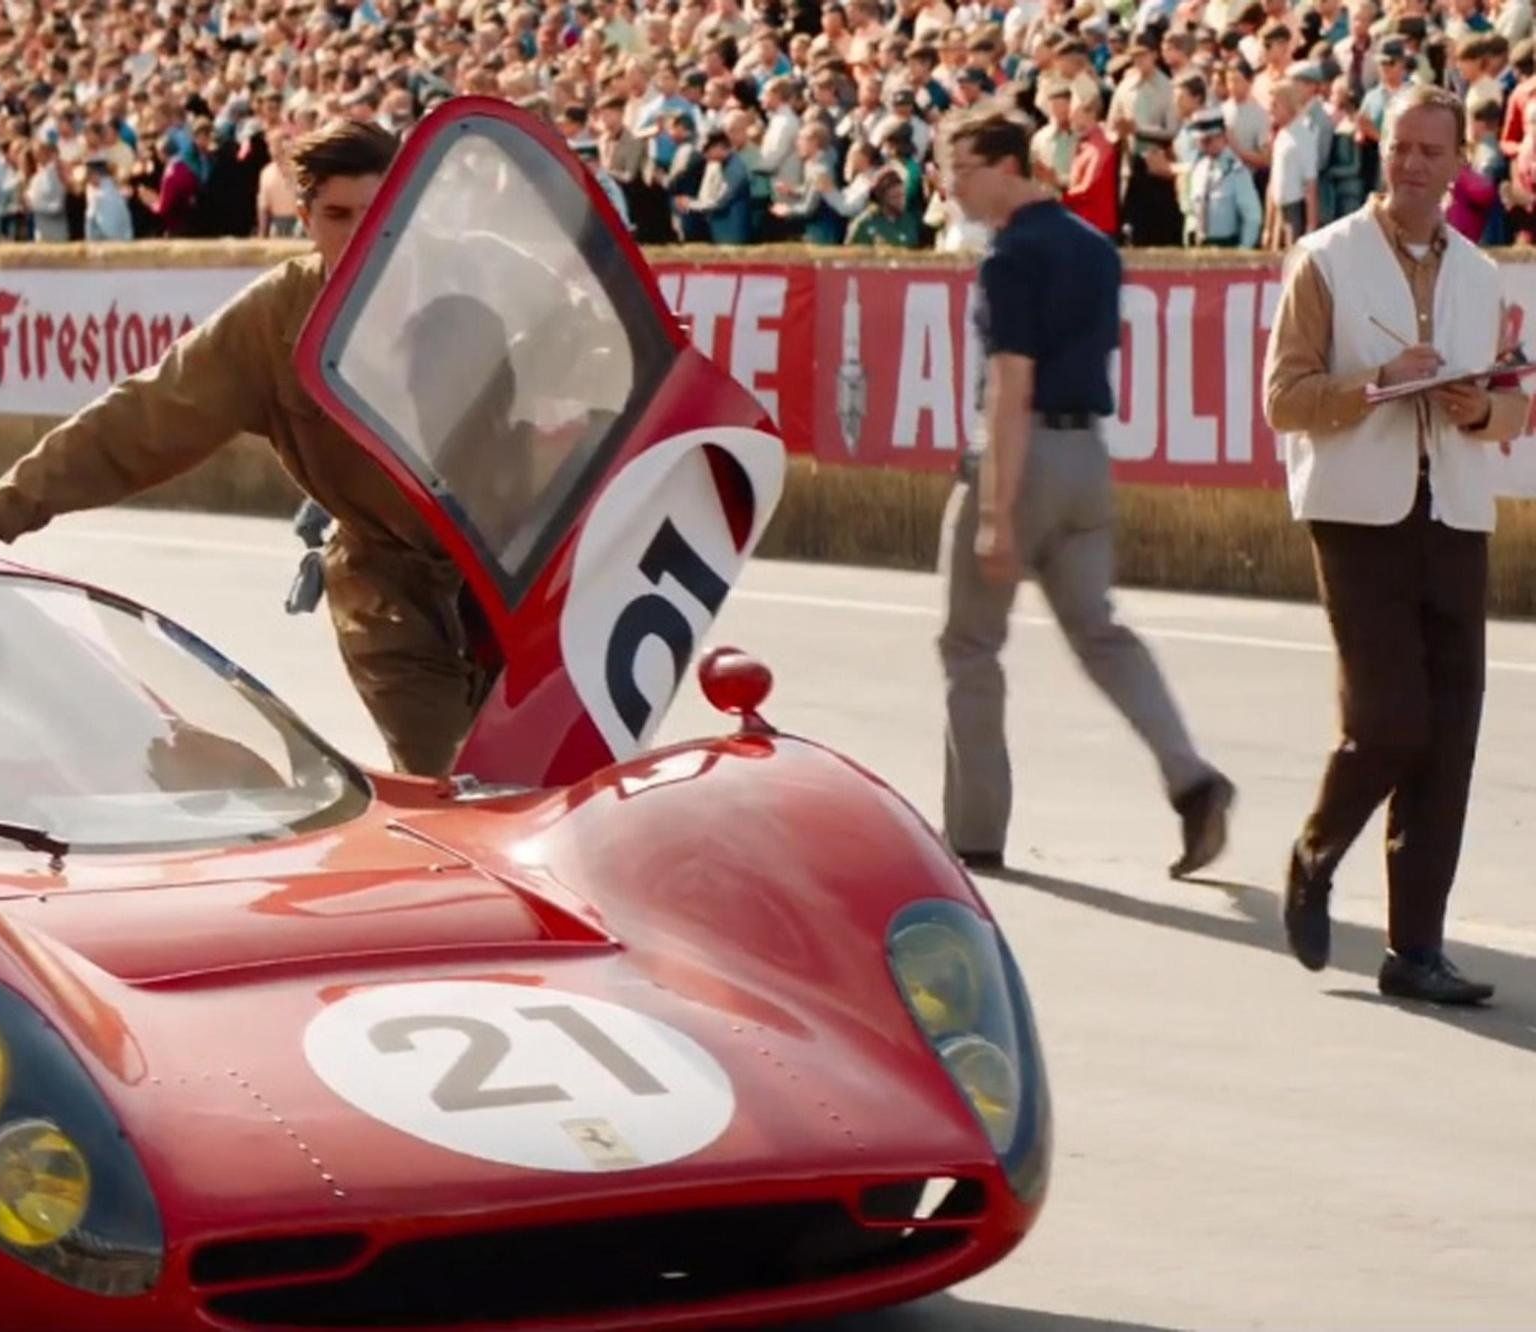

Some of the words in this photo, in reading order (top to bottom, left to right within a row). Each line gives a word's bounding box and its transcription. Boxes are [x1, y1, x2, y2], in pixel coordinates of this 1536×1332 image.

[657, 274, 789, 430] TE
[892, 281, 1288, 464] AOLI
[368, 1004, 670, 1113] 21
